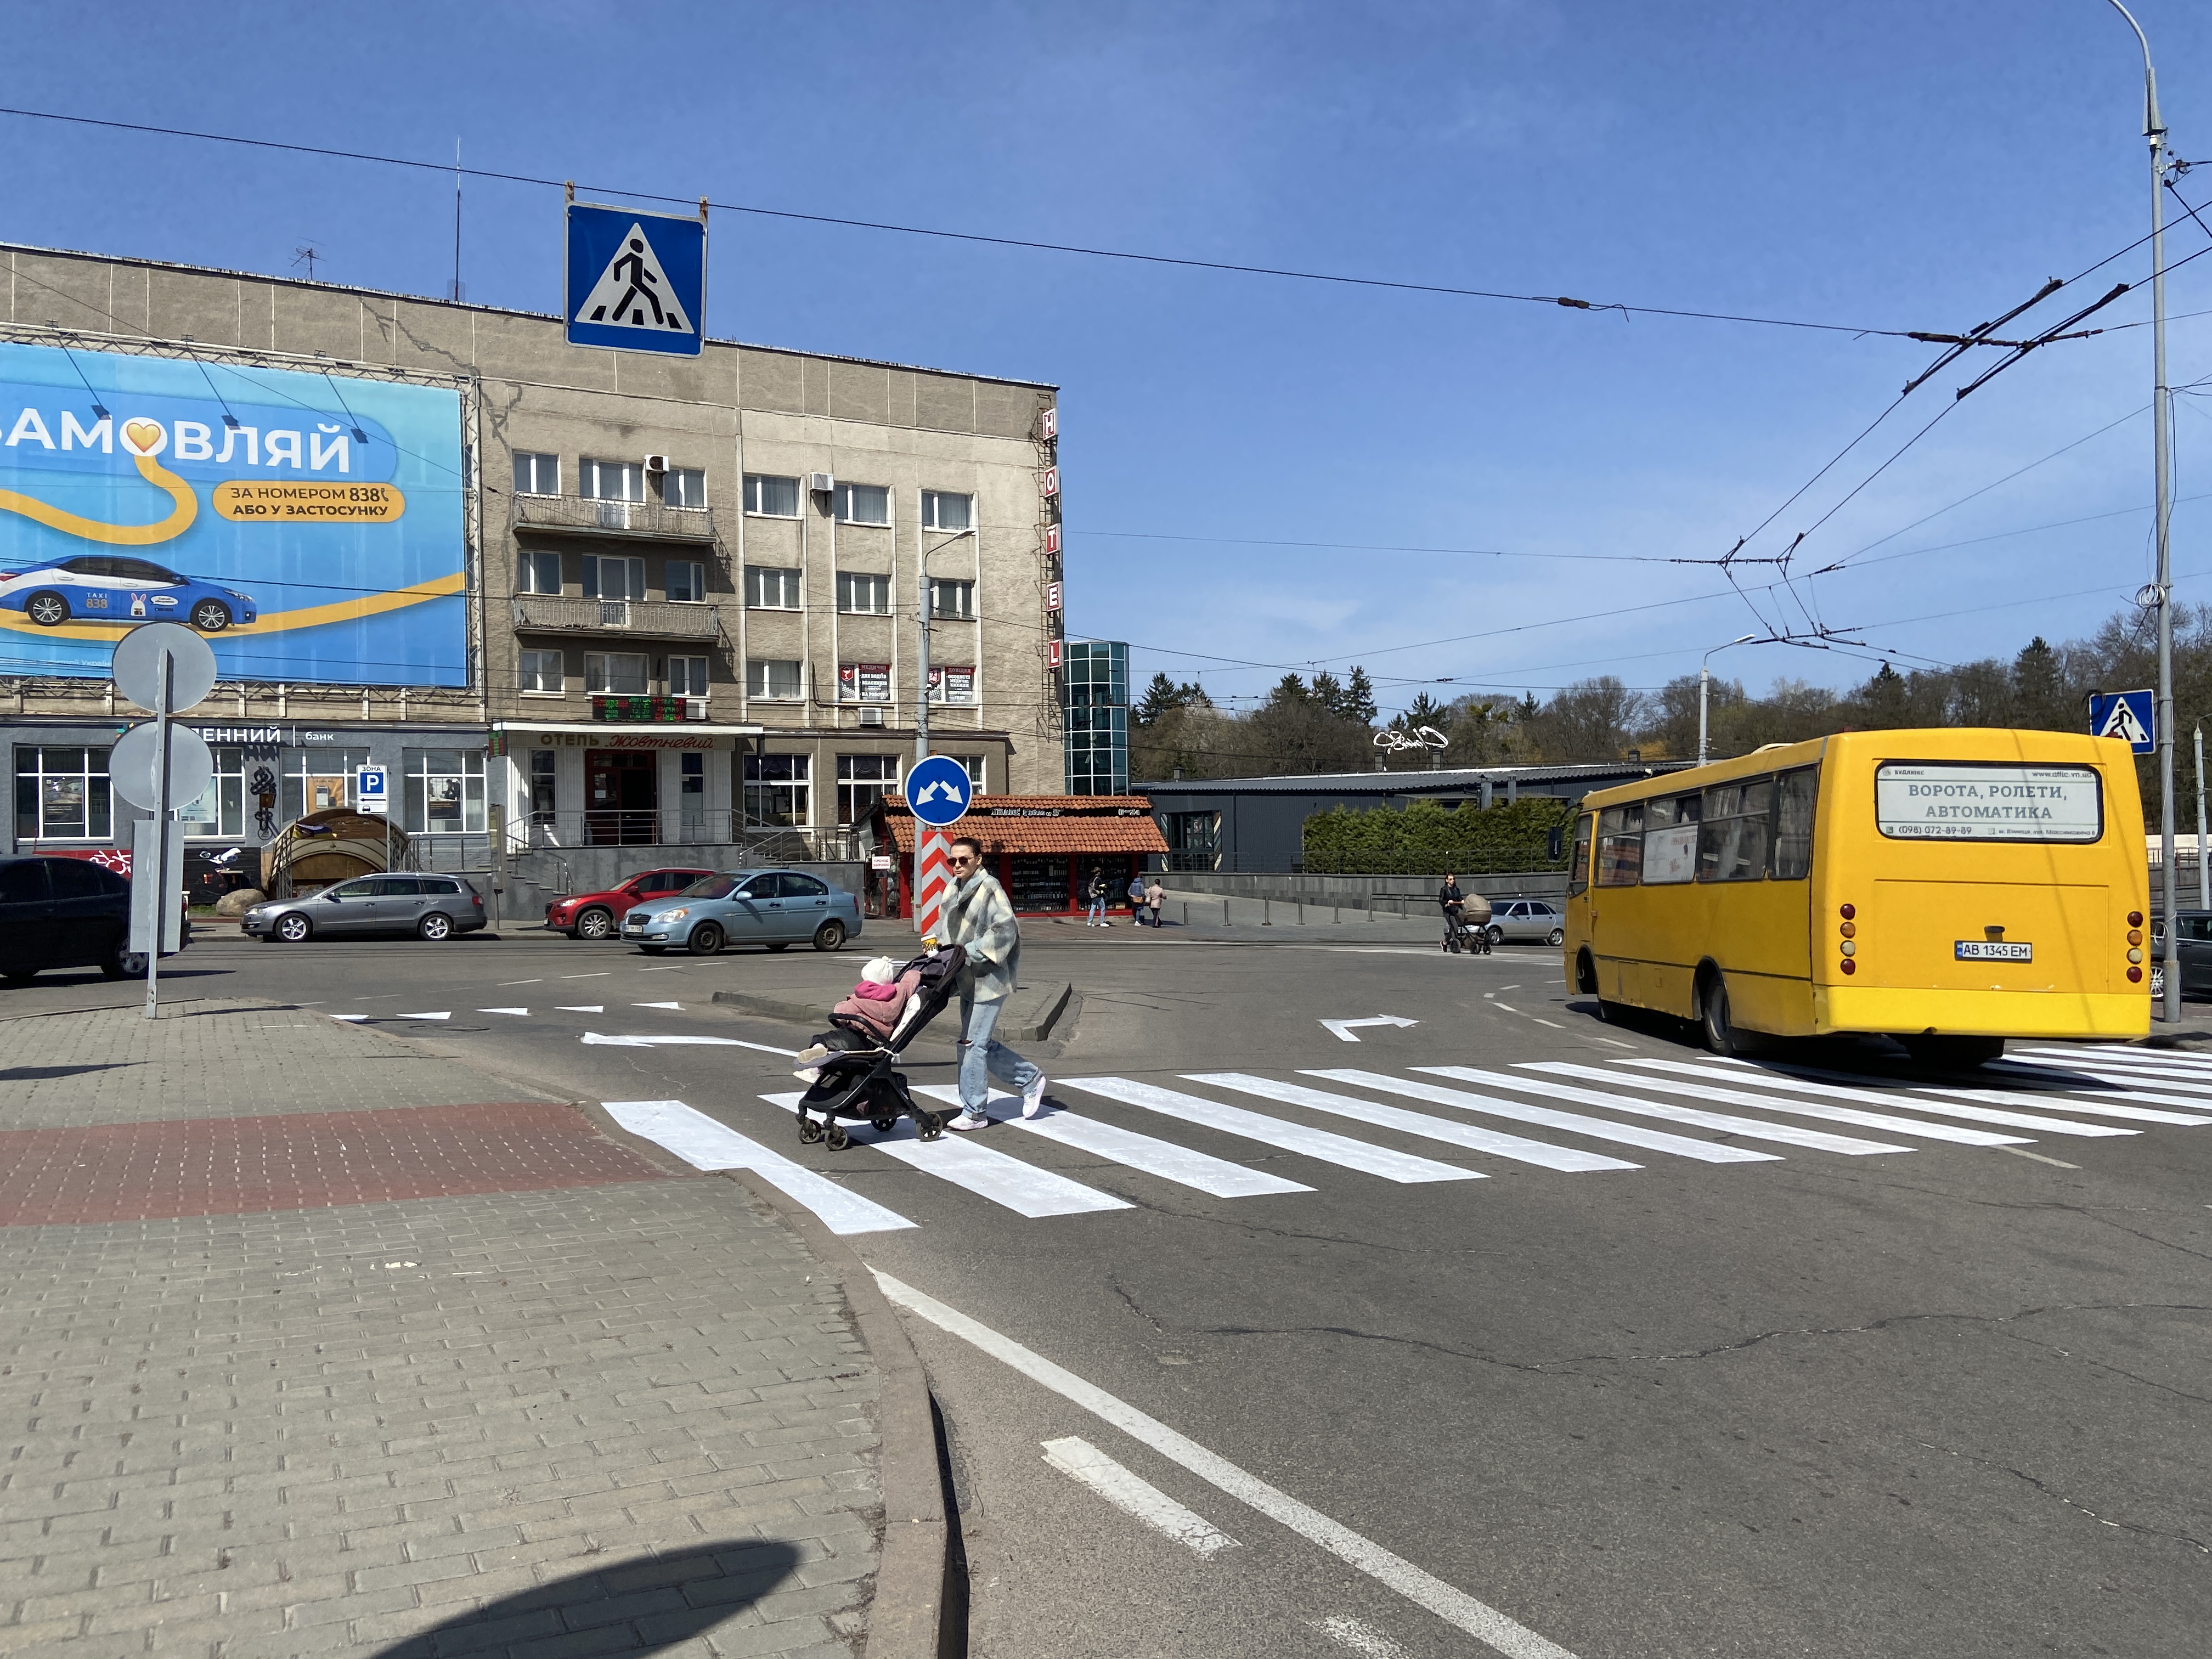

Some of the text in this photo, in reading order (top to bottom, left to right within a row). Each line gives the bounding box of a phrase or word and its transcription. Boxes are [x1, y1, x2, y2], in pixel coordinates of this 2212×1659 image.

[0, 408, 350, 474] АМОВЛЯЙ
[230, 487, 380, 502] ЗА НОМЕРОМ 838
[233, 505, 388, 516] АБО У ЗАСТОСУНКУ
[1043, 414, 1059, 664] HOTEL
[86, 599, 108, 608] 838
[305, 731, 334, 741] банк
[540, 733, 600, 746] ОТЕЛЬ
[1908, 785, 2067, 801] ВОРОТА, РОЛЕТИ,
[1925, 805, 2053, 819] АВТОМАТИКА
[1899, 826, 1922, 834] (098)
[1963, 944, 2027, 957] AB 1345 EM
